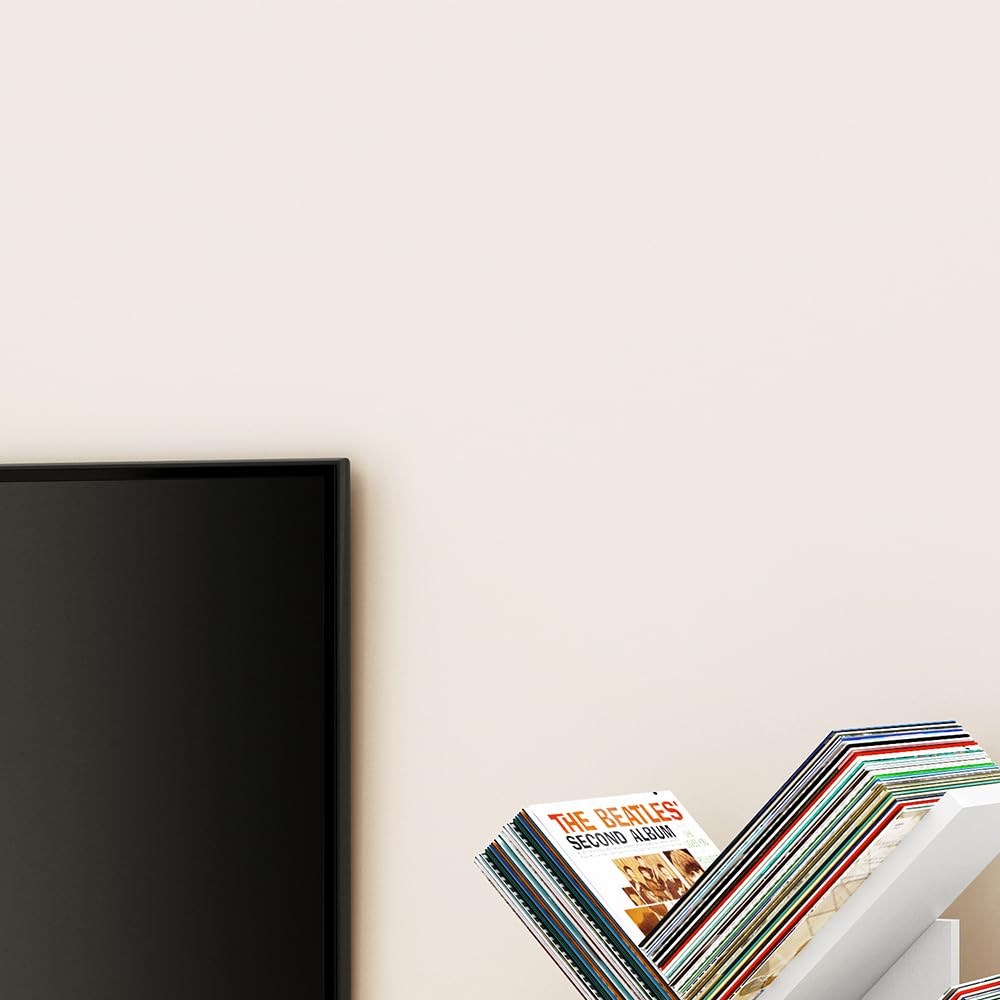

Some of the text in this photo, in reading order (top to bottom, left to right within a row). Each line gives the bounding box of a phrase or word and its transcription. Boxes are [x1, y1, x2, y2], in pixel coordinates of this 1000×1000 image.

[547, 810, 597, 834] THE
[566, 830, 629, 851] SECOND
[630, 824, 677, 844] ALBUM
